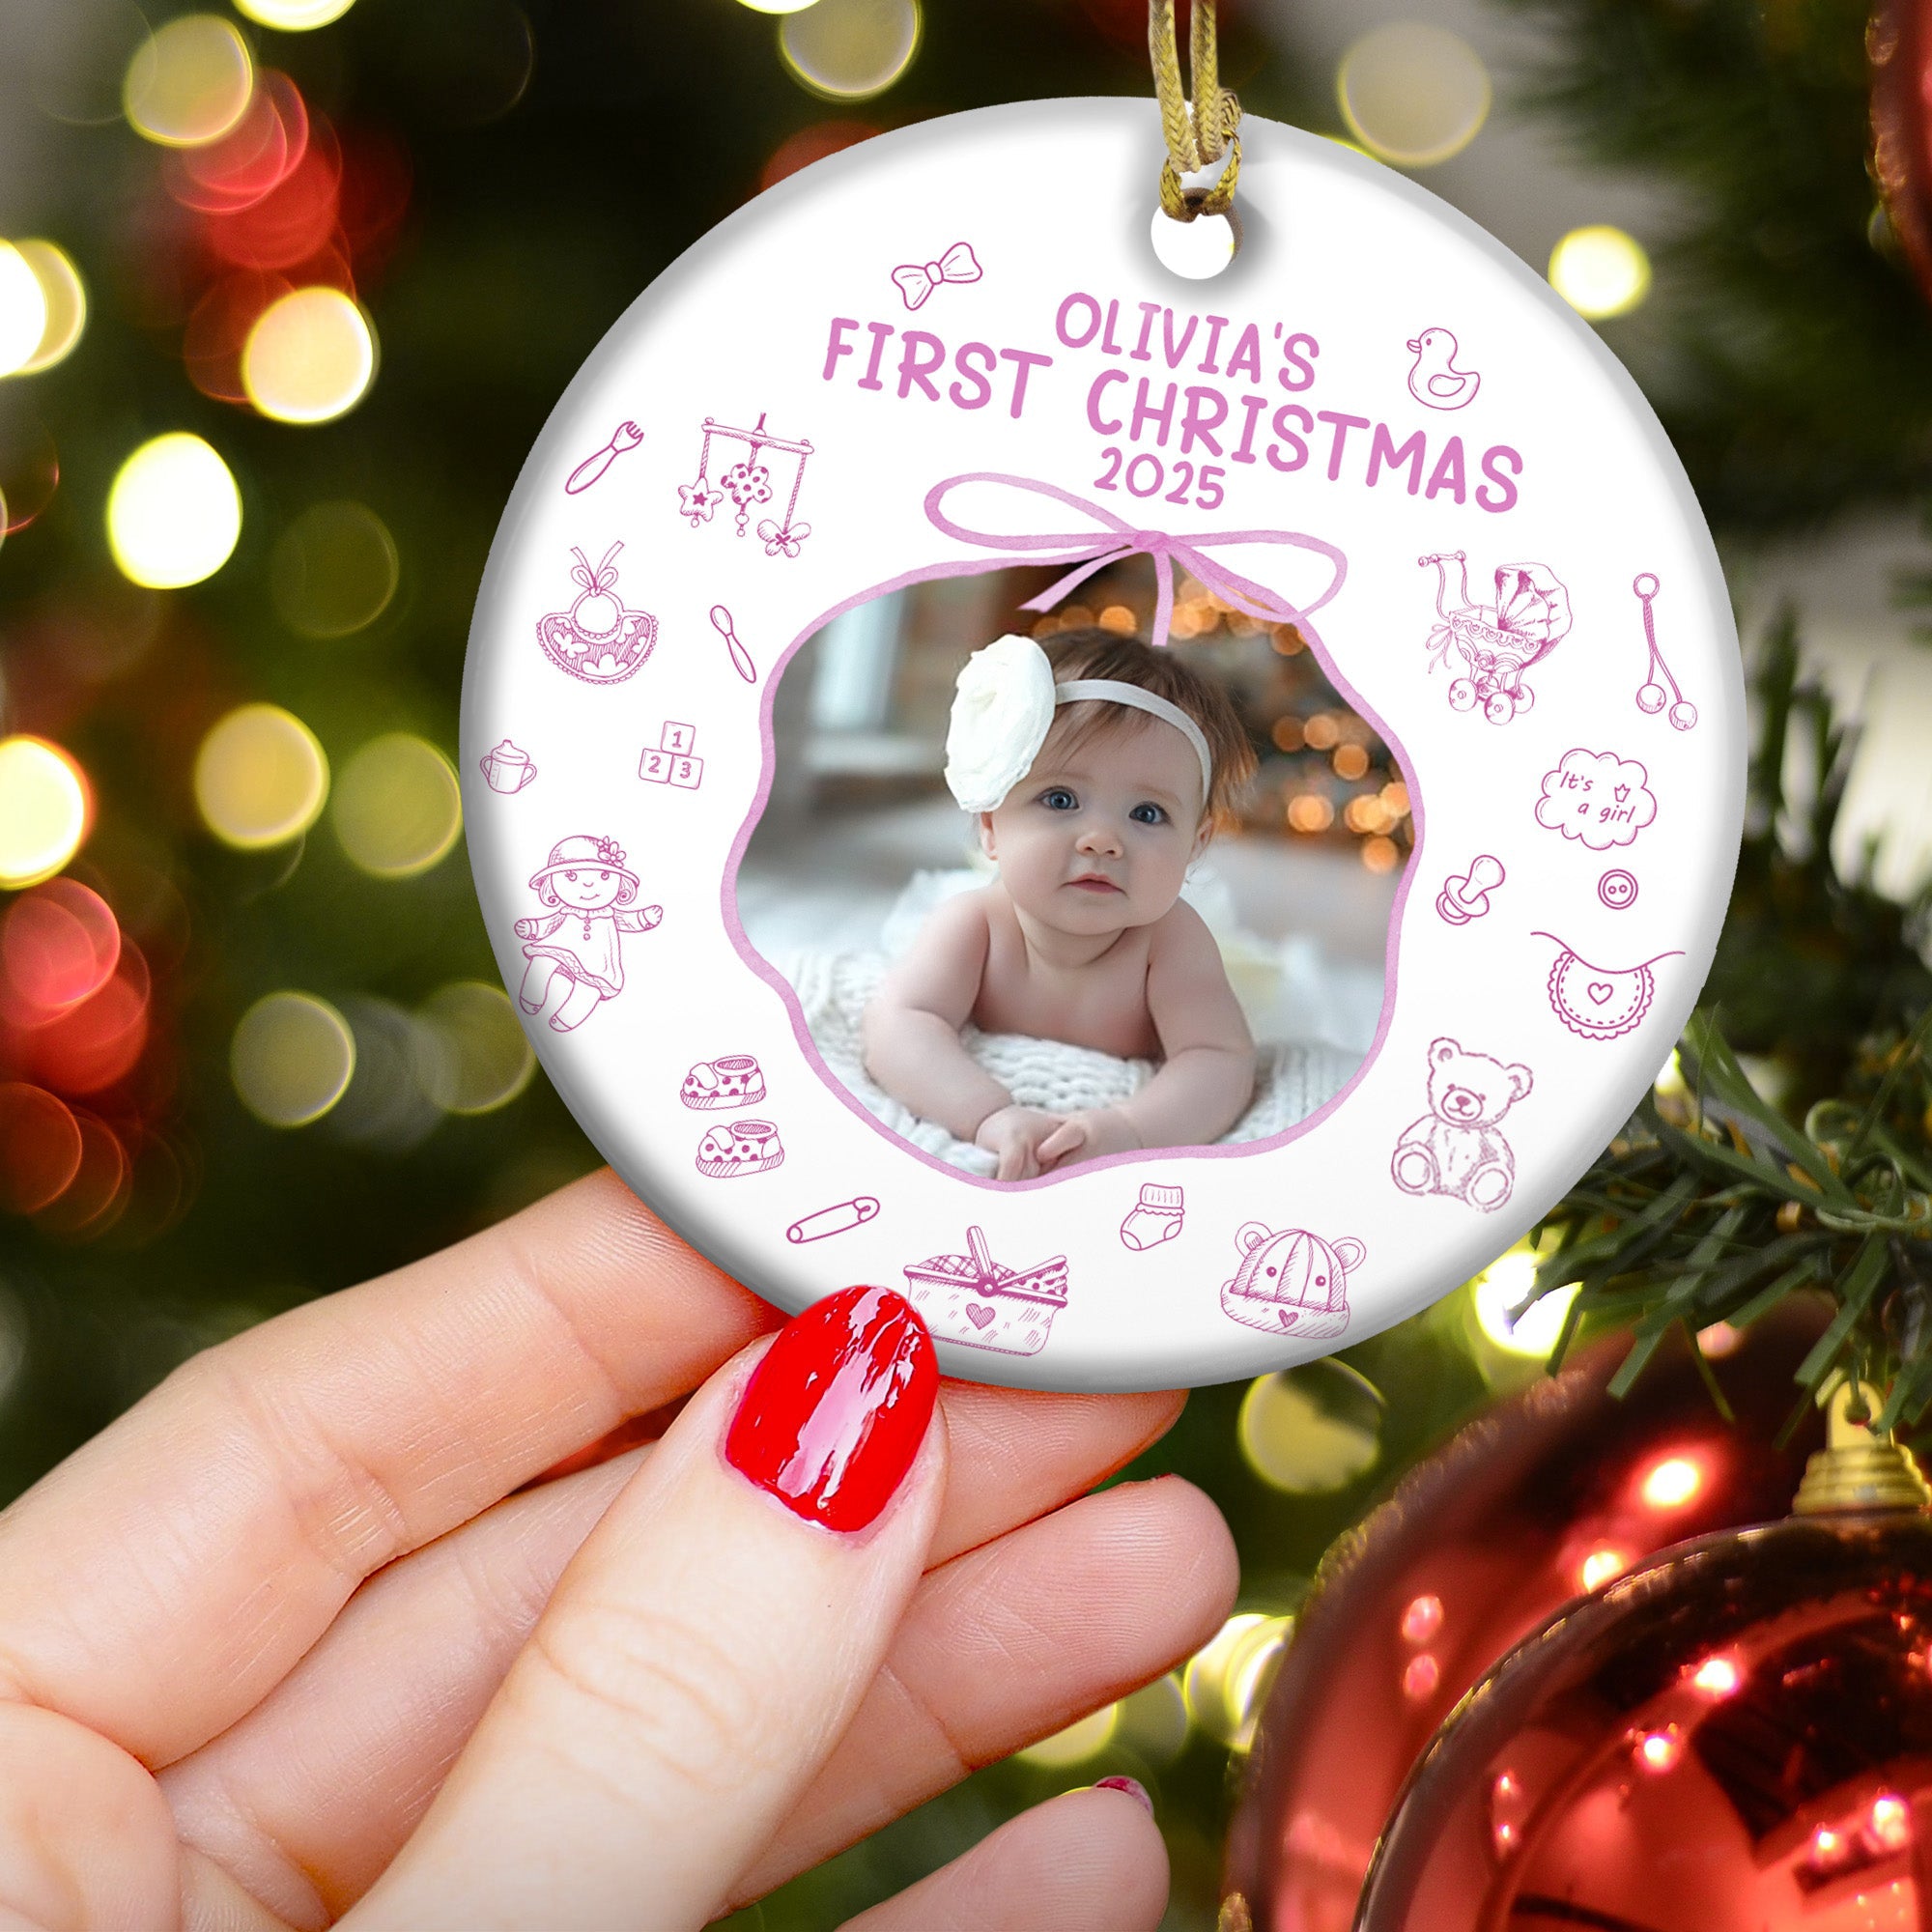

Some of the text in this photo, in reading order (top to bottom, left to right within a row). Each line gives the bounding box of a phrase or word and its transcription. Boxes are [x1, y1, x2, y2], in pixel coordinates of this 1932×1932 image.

[1055, 292, 1320, 392] OLIVIA'S
[822, 317, 1523, 513] FIRST CHRISTMAS
[1094, 446, 1226, 510] 2025
[671, 730, 682, 749] 1
[648, 754, 692, 780] 2 3
[1559, 770, 1595, 792] It's
[1577, 802, 1636, 824] a girl
